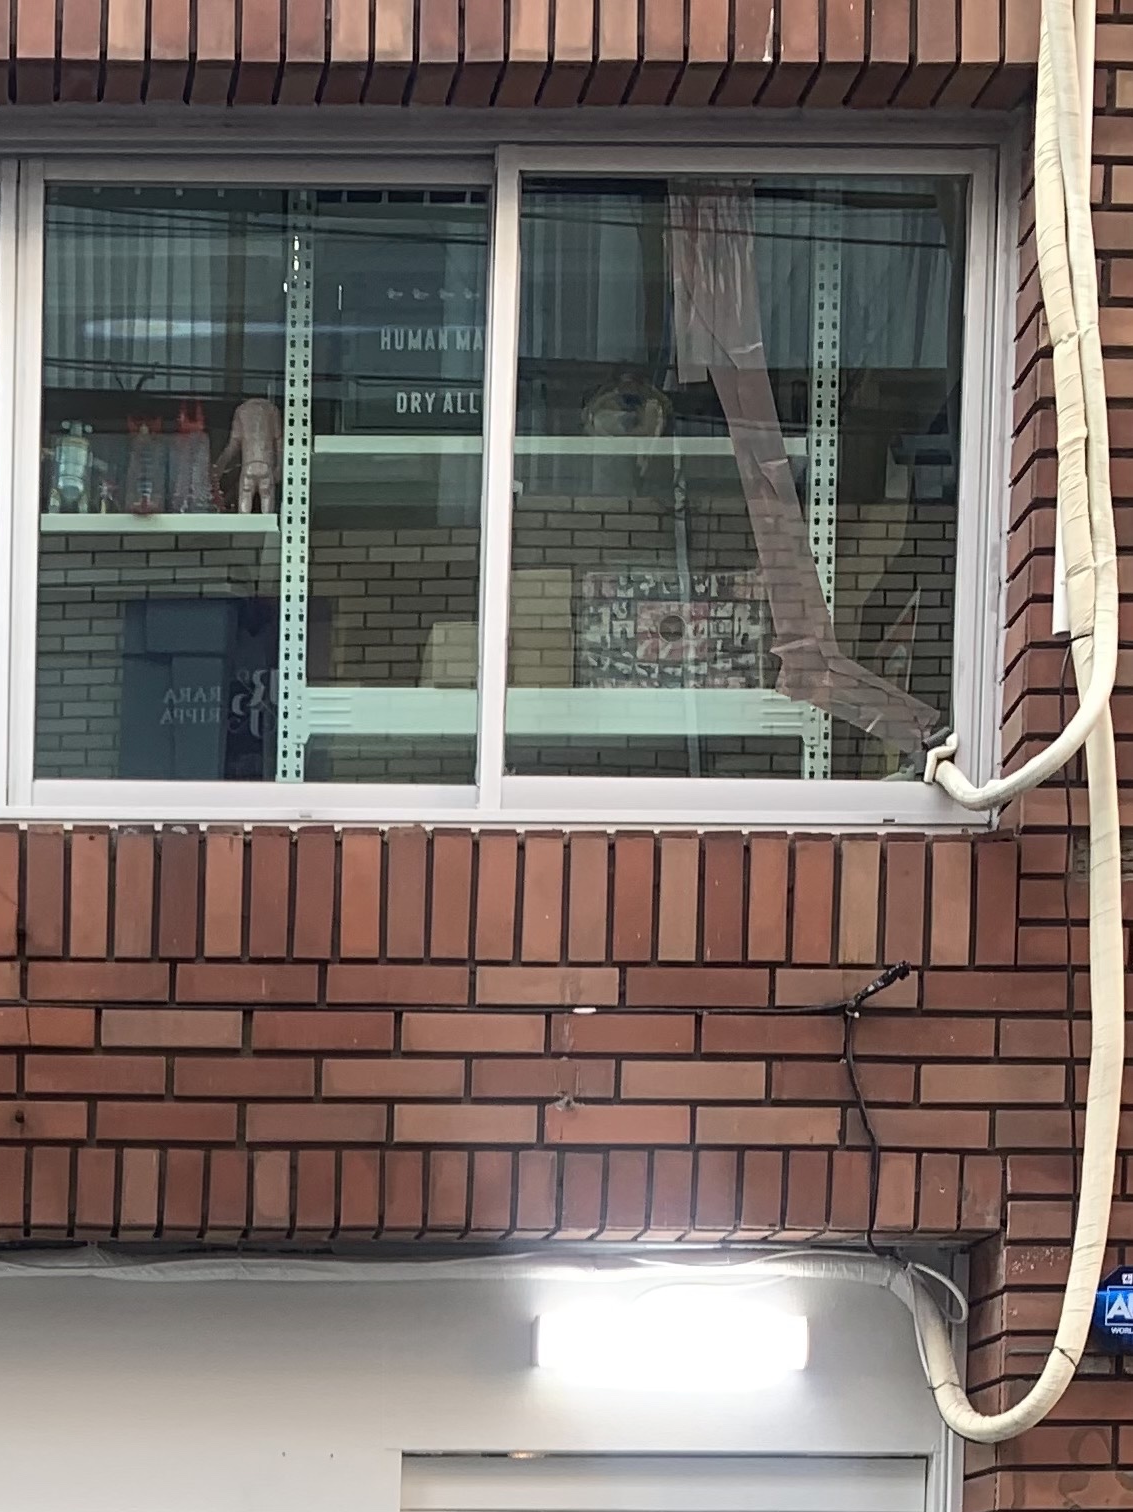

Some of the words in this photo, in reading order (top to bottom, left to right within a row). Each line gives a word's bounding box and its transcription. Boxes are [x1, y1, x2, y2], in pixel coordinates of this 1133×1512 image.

[380, 327, 448, 351] HUMAN
[396, 391, 436, 414] DRY
[443, 391, 479, 414] ALL
